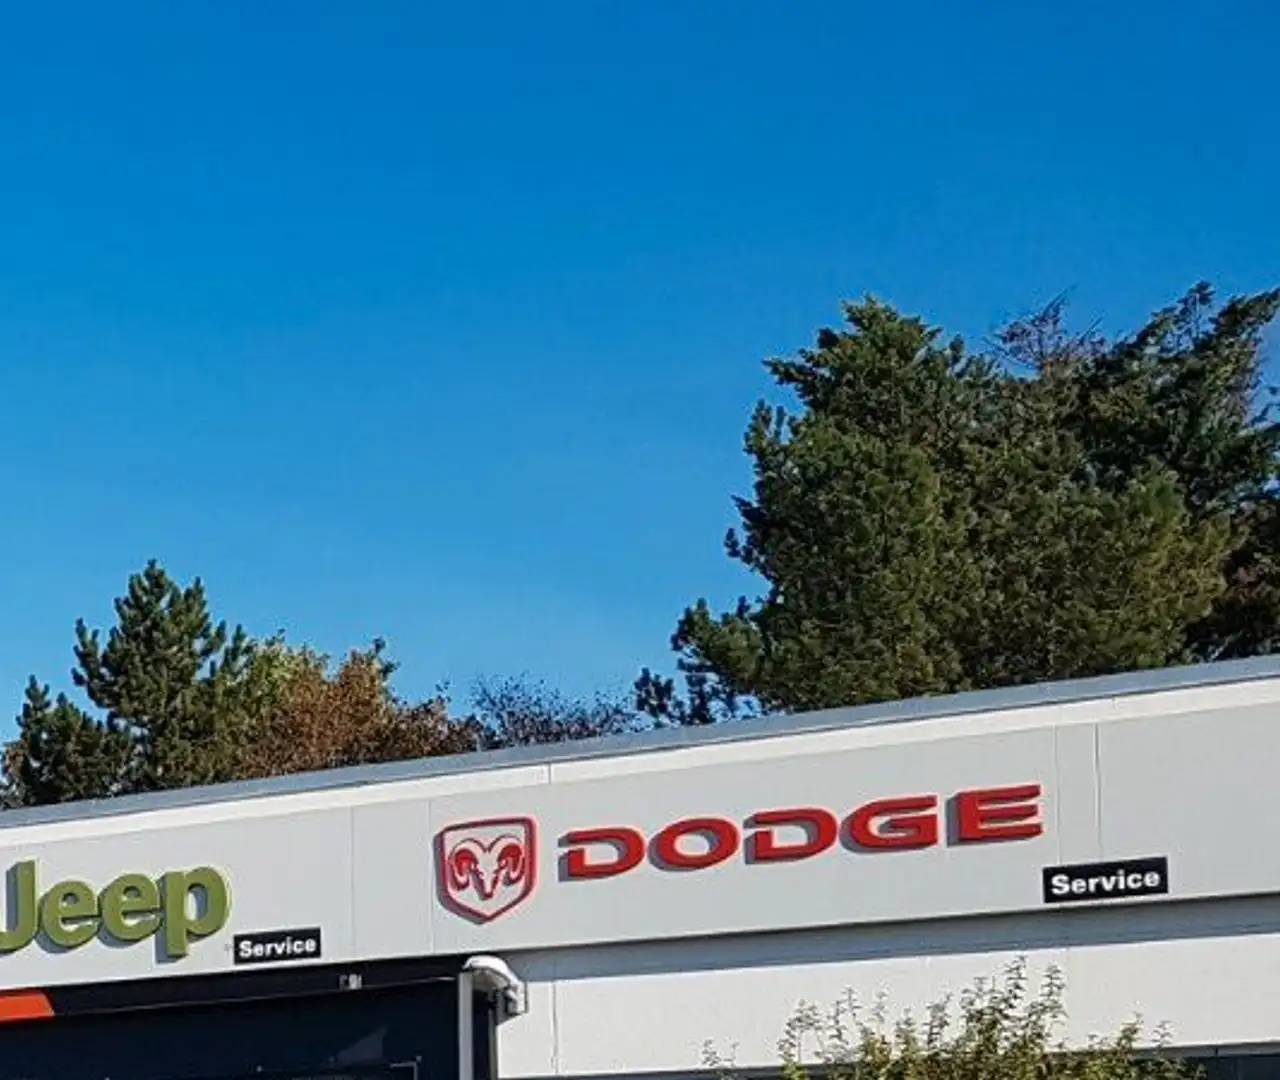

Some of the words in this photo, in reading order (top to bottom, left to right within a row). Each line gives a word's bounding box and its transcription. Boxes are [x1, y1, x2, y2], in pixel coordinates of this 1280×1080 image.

[557, 785, 1043, 881] DODGE
[1051, 869, 1161, 895] Service
[239, 936, 317, 959] Service
